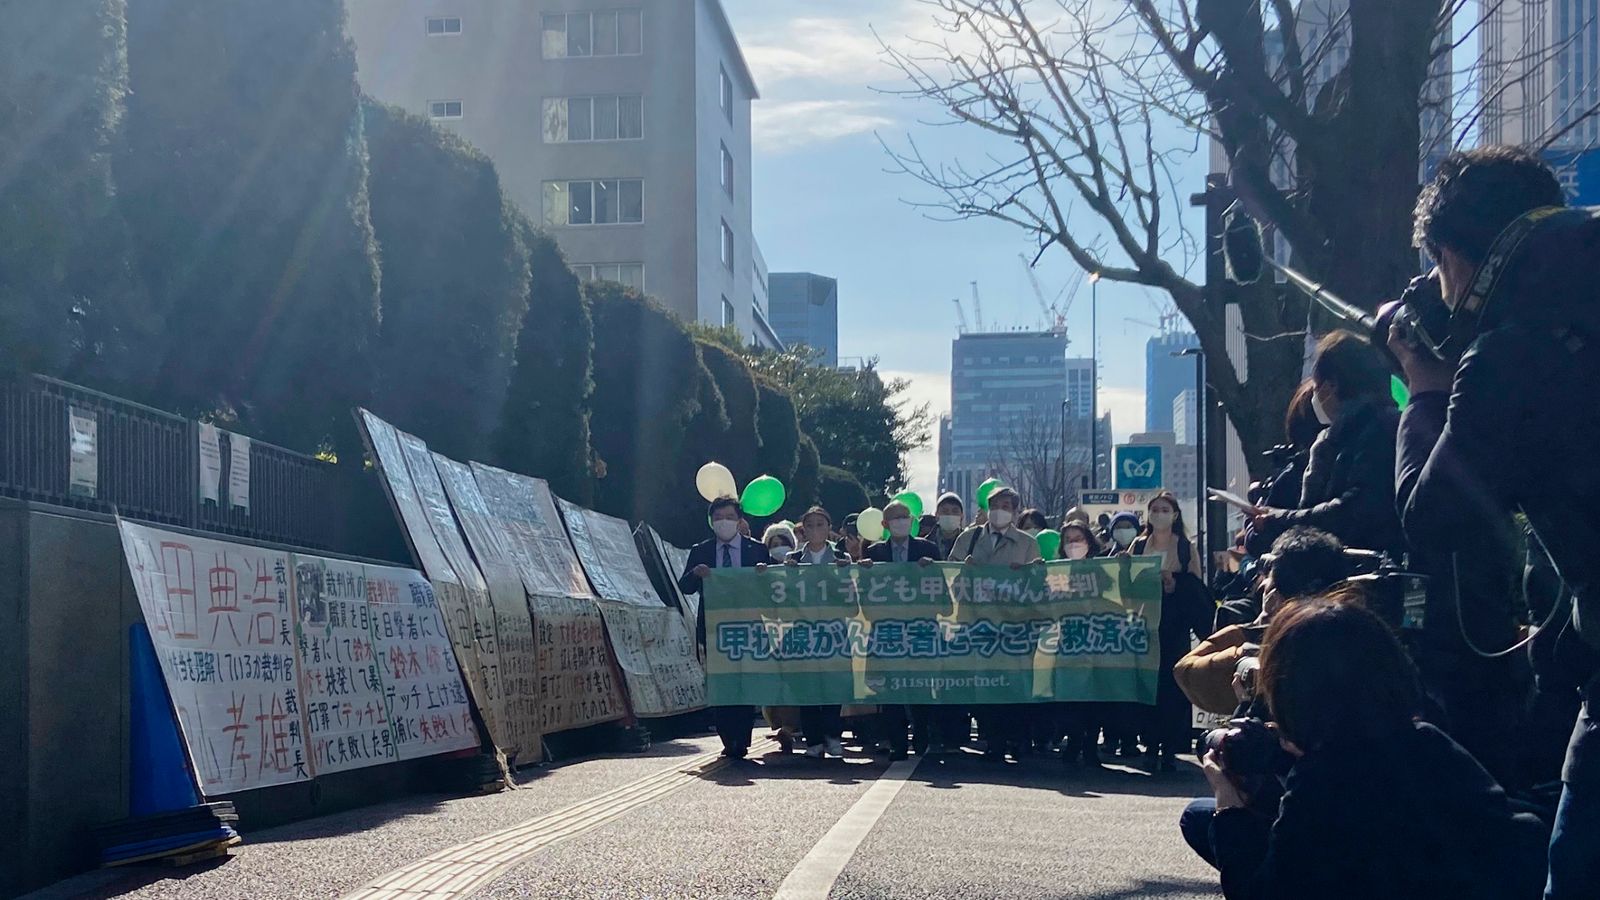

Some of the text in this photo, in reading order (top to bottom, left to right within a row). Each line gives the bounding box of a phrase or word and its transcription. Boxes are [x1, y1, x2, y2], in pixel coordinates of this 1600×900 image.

[718, 614, 1148, 660] 甲状腺がん患者に今こそ救済を
